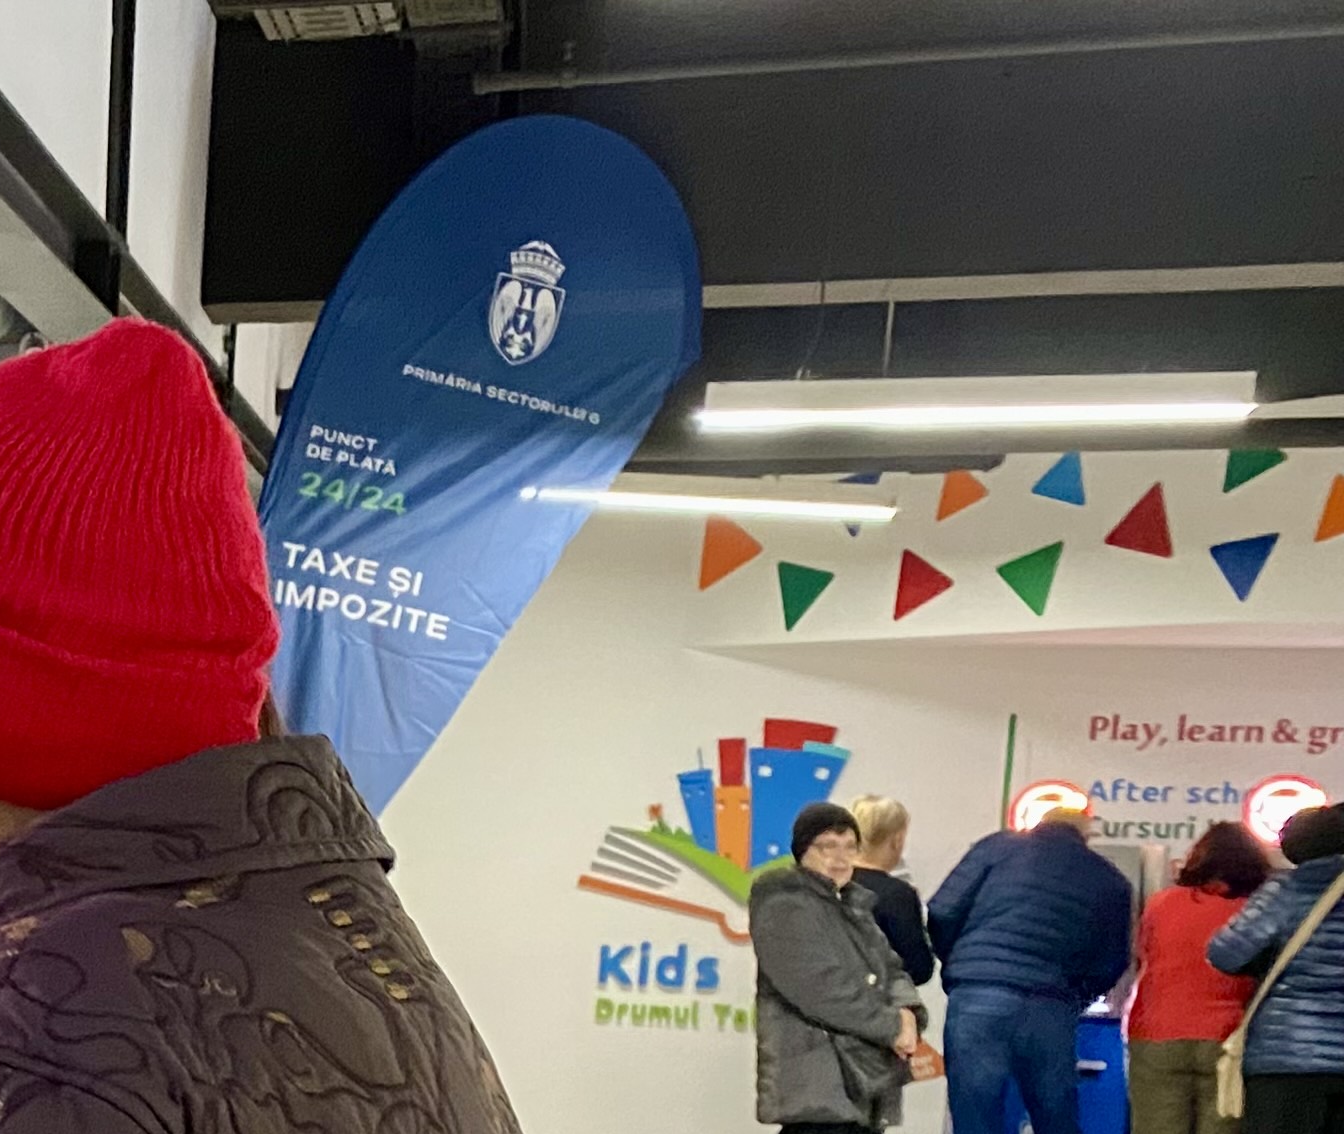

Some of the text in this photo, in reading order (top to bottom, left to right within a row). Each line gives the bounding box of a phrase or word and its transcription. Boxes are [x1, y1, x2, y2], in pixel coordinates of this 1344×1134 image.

[486, 385, 587, 422] SECTORULUI
[588, 411, 601, 426] 6
[310, 424, 378, 452] PUNCT
[306, 443, 397, 477] DE PLATĂ
[297, 471, 407, 516] 24/24
[282, 541, 424, 599] TAXE ȘI
[274, 580, 451, 641] IMPOZITE
[1089, 714, 1168, 750] Play,
[1177, 714, 1264, 743] learn
[1271, 718, 1298, 744] &
[1088, 778, 1173, 802] After
[597, 941, 721, 991] Kids
[594, 997, 757, 1034] Drumul Ta
